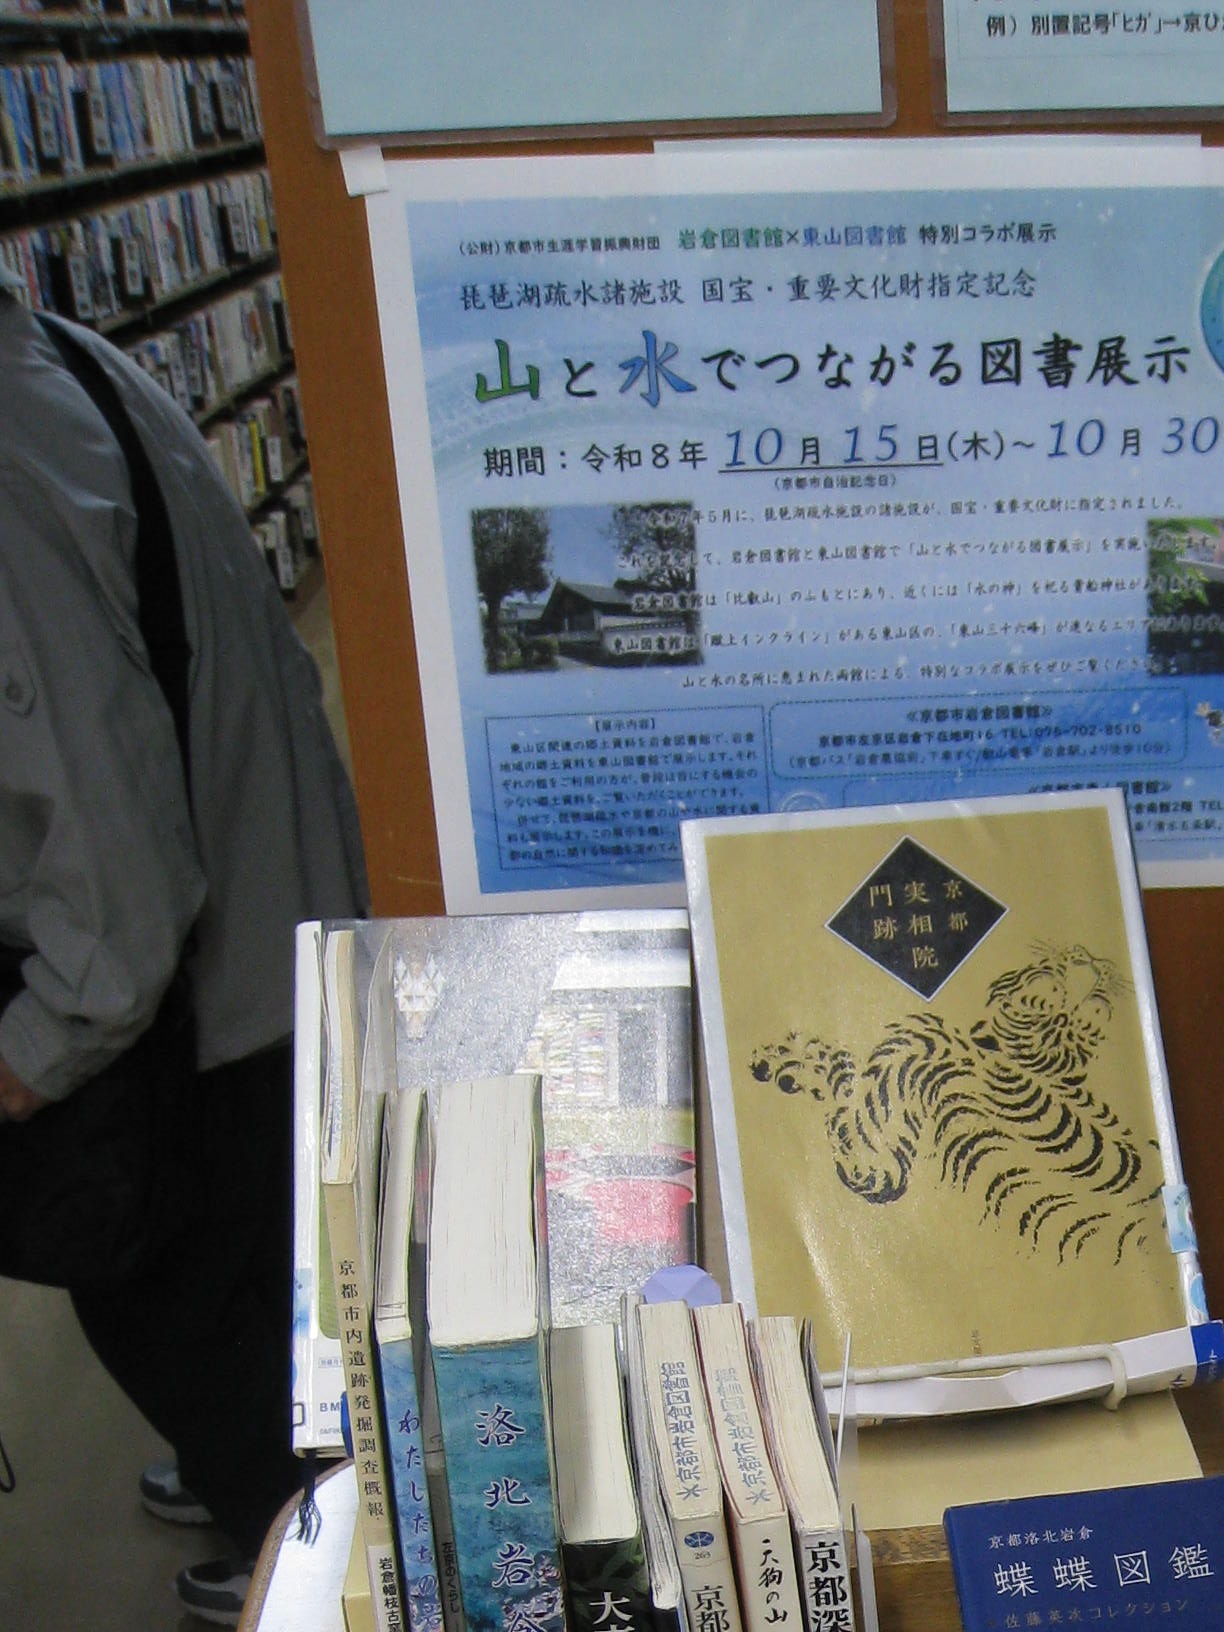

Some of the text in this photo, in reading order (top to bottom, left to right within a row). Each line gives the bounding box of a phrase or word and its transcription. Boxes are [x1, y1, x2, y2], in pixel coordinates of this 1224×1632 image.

[918, 221, 1057, 245] 特別コラボ展示
[459, 268, 1037, 312] 琵琶湖疏水諸施設 国宝・重要文化財指定記念
[476, 330, 1191, 408] 山と水でつながる図書展示
[869, 883, 899, 941] 門跡
[904, 881, 939, 969] 実相院
[943, 878, 969, 932] 京都
[338, 1260, 384, 1521] 京都市内遺跡発掘調査概報
[989, 1525, 1094, 1549] 京都洛北岩倉
[993, 1543, 1215, 1598] 蝶蝶図鑑
